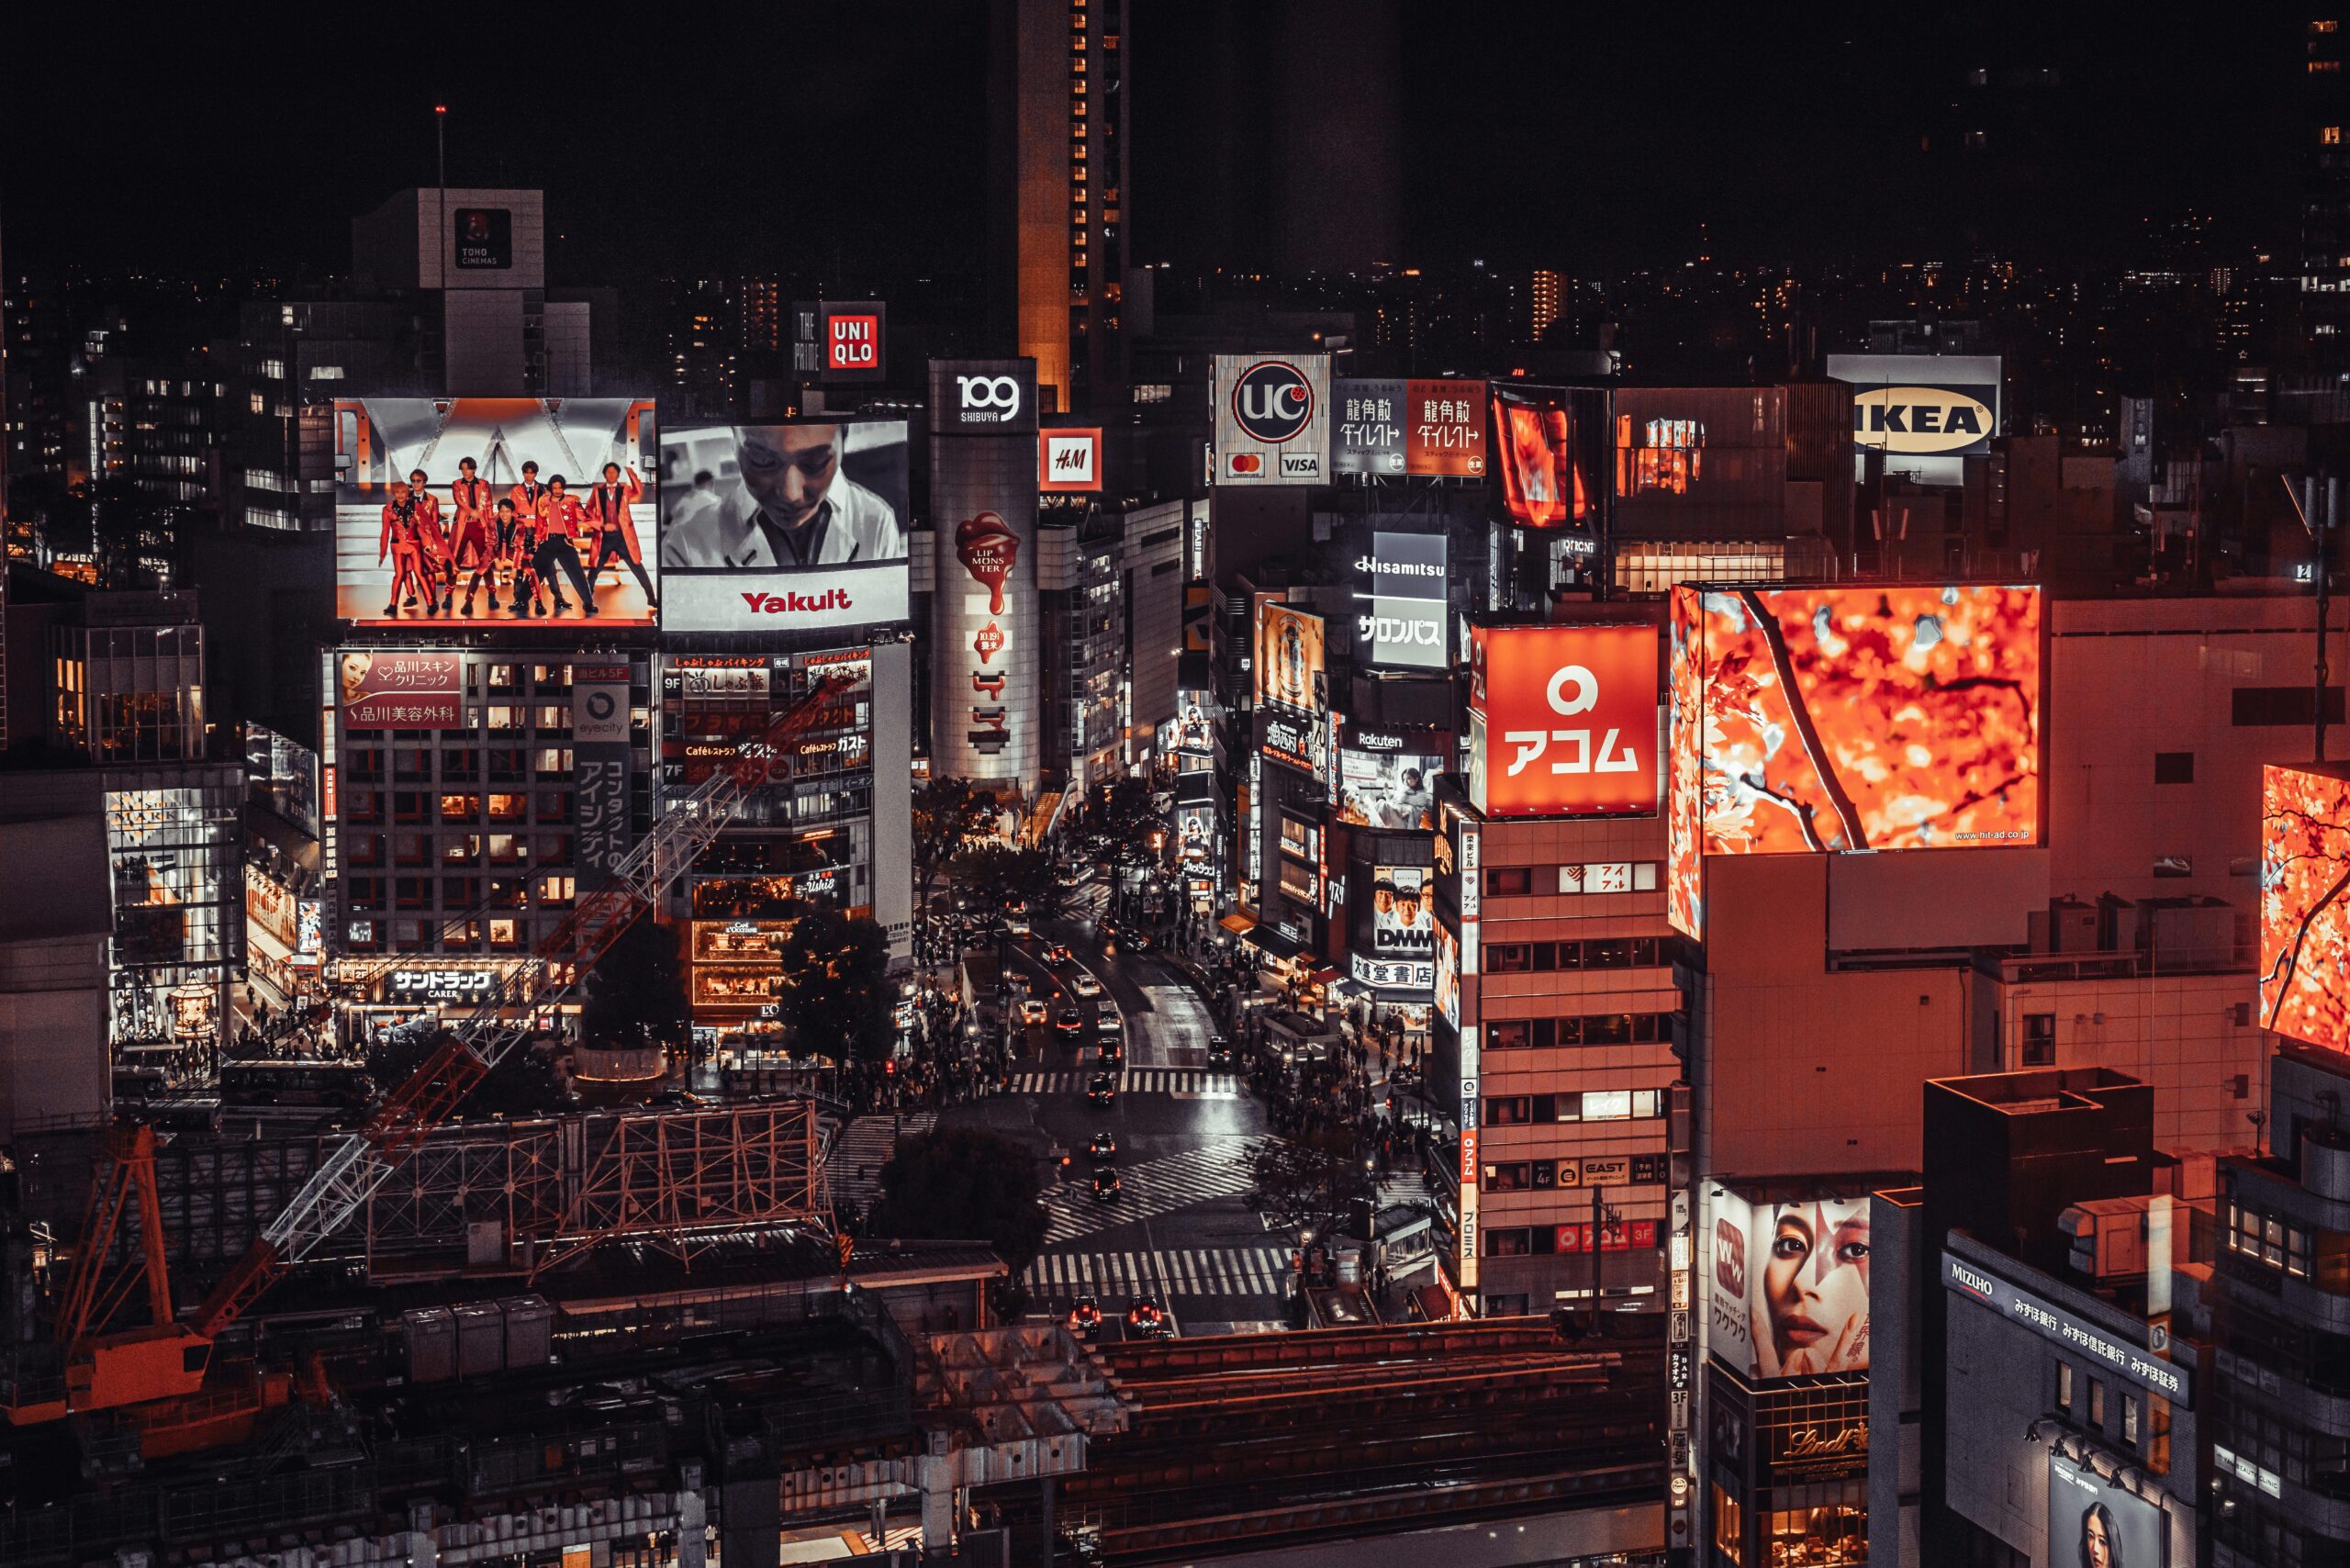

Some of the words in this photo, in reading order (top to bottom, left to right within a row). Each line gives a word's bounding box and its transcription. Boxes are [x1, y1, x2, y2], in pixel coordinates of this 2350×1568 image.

[462, 248, 487, 256] TOHO
[800, 313, 814, 340] THE
[834, 322, 868, 340] UNI
[795, 342, 820, 371] PRIME
[834, 343, 872, 364] QLO
[957, 375, 1020, 421] 109
[961, 412, 998, 421] SHIBUYA
[1347, 398, 1392, 421] 龍角散
[1425, 399, 1471, 423] 龍角散
[1056, 449, 1086, 469] H&M
[1282, 459, 1317, 471] VISA
[980, 565, 1000, 573] TER
[1355, 555, 1445, 577] Hisamitsu
[741, 588, 853, 614] Yakult
[1359, 616, 1441, 646] サロンパス
[394, 660, 454, 673] 品川スキン
[395, 674, 448, 687] クリニック
[665, 678, 680, 689] 9F
[360, 706, 454, 722] 品川美容外科
[579, 722, 623, 734] eyecity
[1359, 733, 1403, 747] Rakuten
[1505, 728, 1639, 777] アコム
[665, 765, 683, 777] 7F
[580, 762, 602, 868] アイシティ
[1954, 829, 2030, 840] www.hit-ad.co.jp
[1355, 958, 1431, 982] 大盛堂書店
[395, 971, 491, 990] サンドラッグ
[1464, 1149, 1473, 1176] アコム
[1585, 1162, 1626, 1173] EAST
[1537, 1172, 1550, 1184] 4F
[1463, 1210, 1474, 1259] プロミス
[1635, 1229, 1652, 1240] 3F
[1952, 1263, 1993, 1295] MIZUHO
[1714, 1306, 1746, 1342] ワクワク
[2014, 1298, 2057, 1331] みずほ銀行
[2062, 1322, 2125, 1366] みずほ信託銀行
[2131, 1357, 2179, 1392] みずほ証券
[1672, 1353, 1680, 1383] カラオケ
[1672, 1393, 1687, 1404] 3F
[1783, 1429, 1854, 1457] Lindt
[2259, 1475, 2277, 1489] CLINIC
